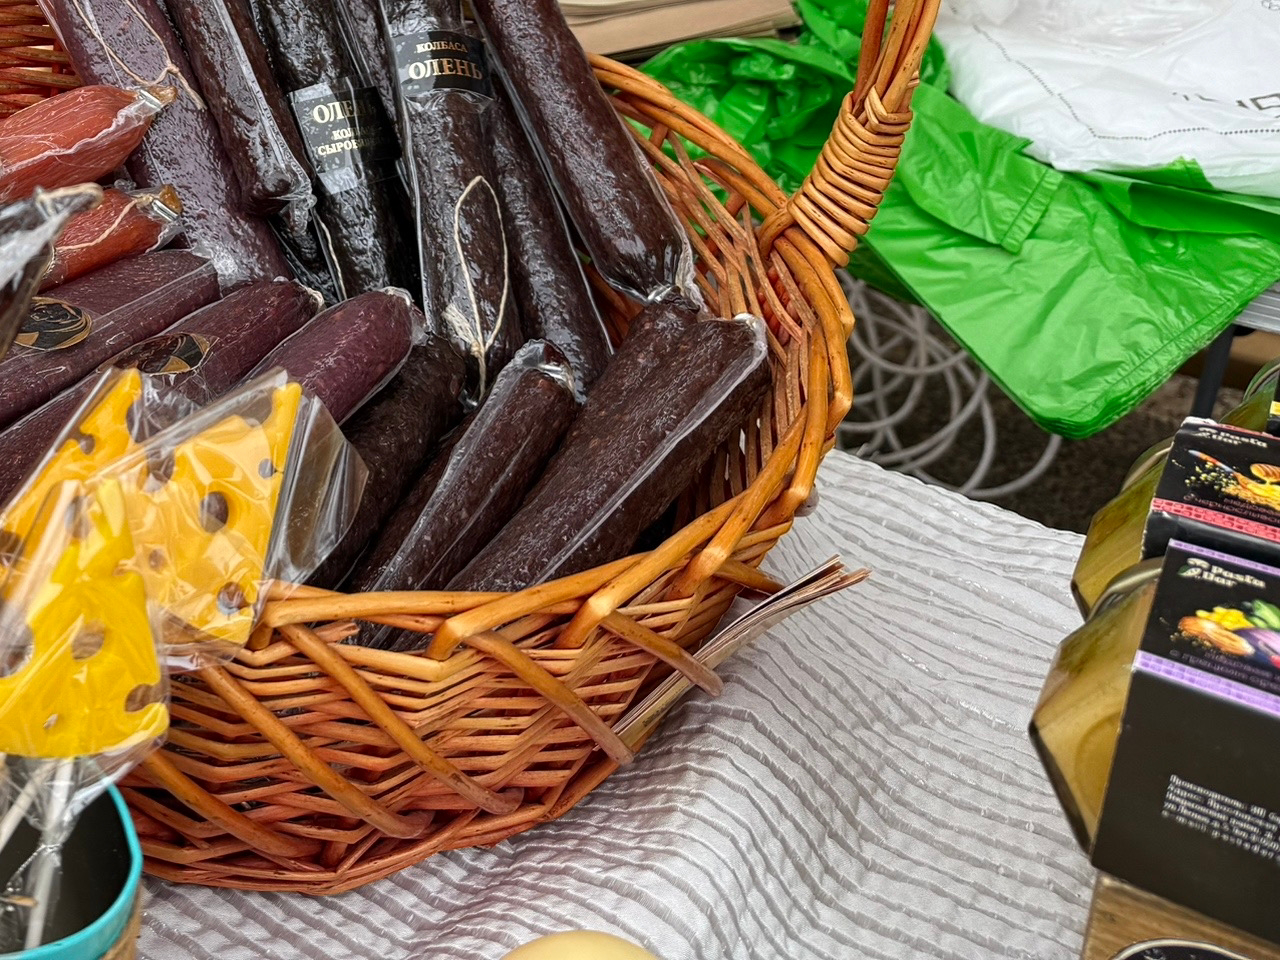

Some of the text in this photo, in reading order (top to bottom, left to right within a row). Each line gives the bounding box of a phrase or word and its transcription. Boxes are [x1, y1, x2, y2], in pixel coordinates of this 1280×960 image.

[415, 41, 468, 53] КОЛБАСА
[408, 57, 484, 80] ОЛЕНЬ
[1210, 564, 1266, 589] Pasta
